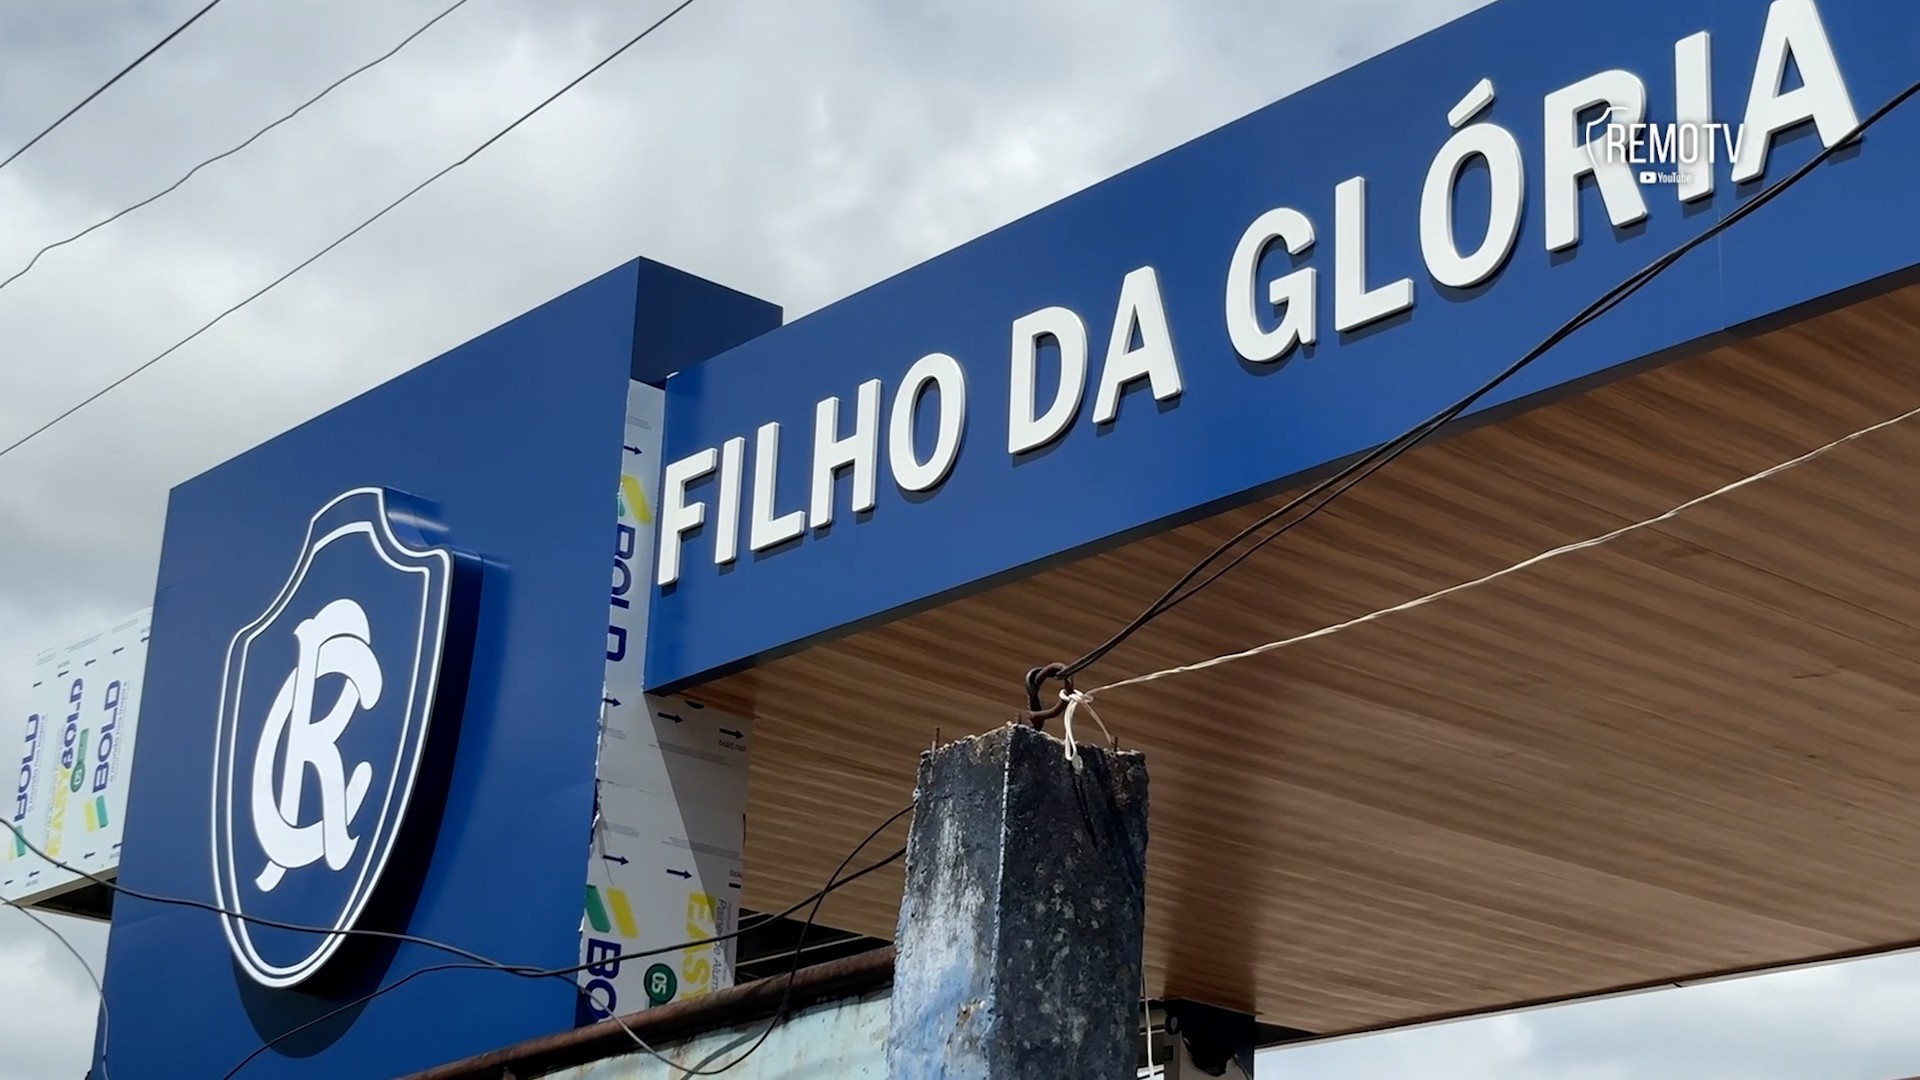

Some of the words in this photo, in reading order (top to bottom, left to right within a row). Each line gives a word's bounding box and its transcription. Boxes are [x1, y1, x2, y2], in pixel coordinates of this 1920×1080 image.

[658, 352, 966, 588] FILHO
[1008, 265, 1182, 455] DA
[1225, 0, 1860, 363] GLÓRIA
[14, 713, 39, 822] BOLD
[61, 678, 84, 769] BOLD
[92, 680, 121, 793] BOLD
[651, 971, 668, 995] 05
